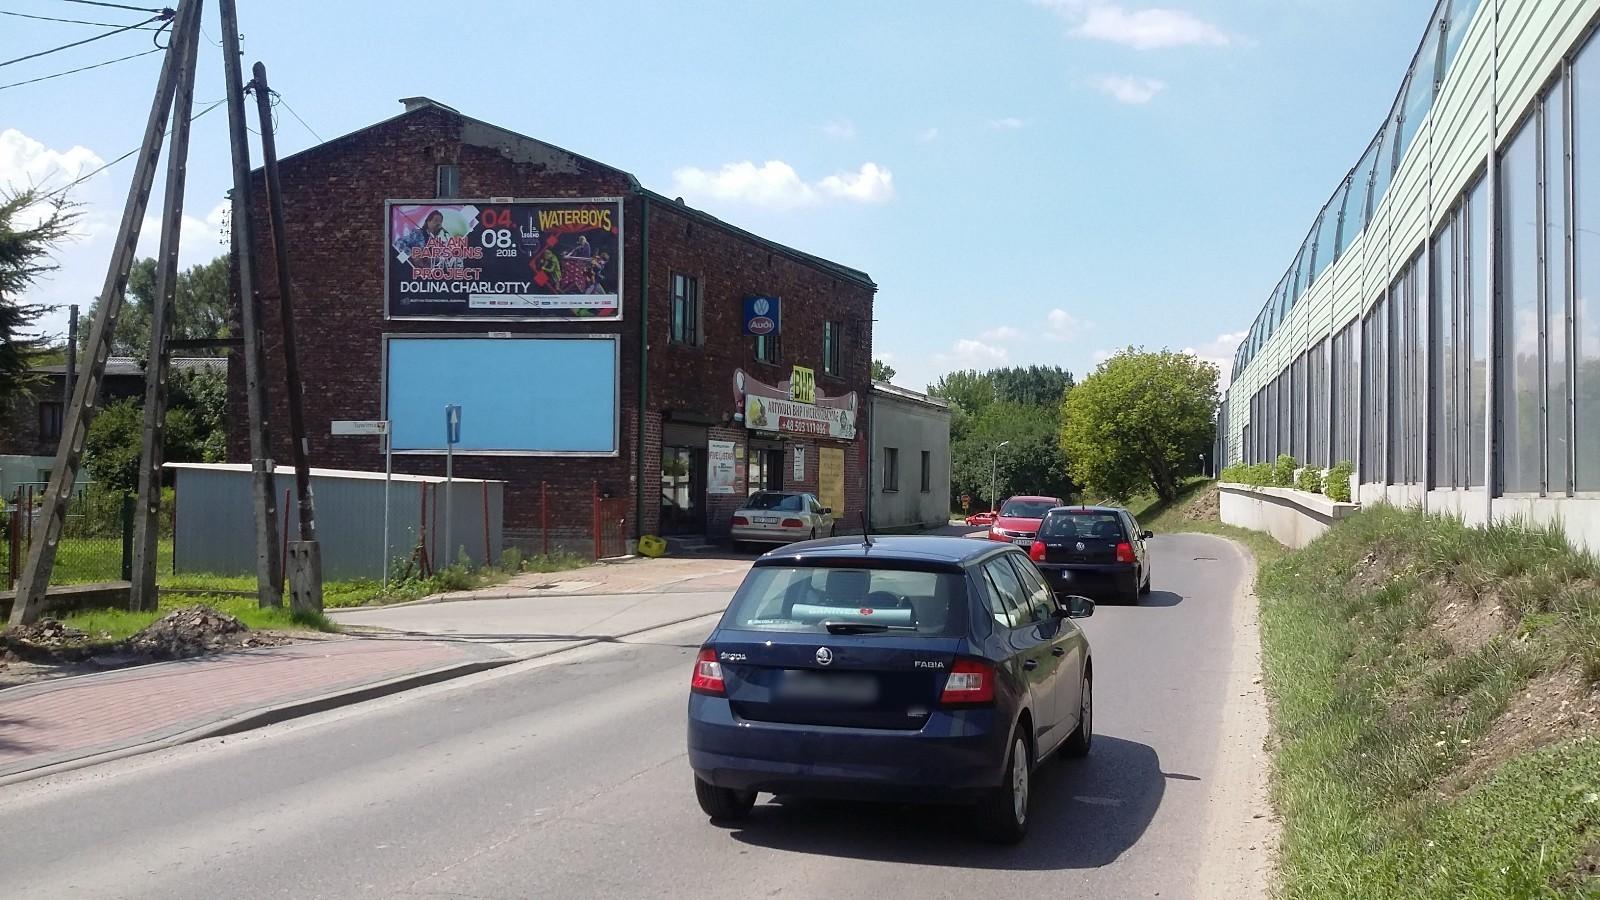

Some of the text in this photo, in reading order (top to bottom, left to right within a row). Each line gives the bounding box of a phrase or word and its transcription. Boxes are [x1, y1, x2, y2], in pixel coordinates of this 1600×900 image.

[481, 209, 517, 227] 04.
[538, 209, 612, 232] WATERBOYS
[427, 236, 469, 248] ALAN
[481, 229, 517, 248] 08.
[411, 247, 483, 258] PARSONS
[496, 249, 517, 257] 2018
[412, 267, 483, 280] PROJECT
[400, 281, 531, 293] DOLINA CHARLOTTY
[794, 369, 813, 401] BHP
[793, 405, 803, 416] BHP
[914, 660, 945, 669] FABIA
